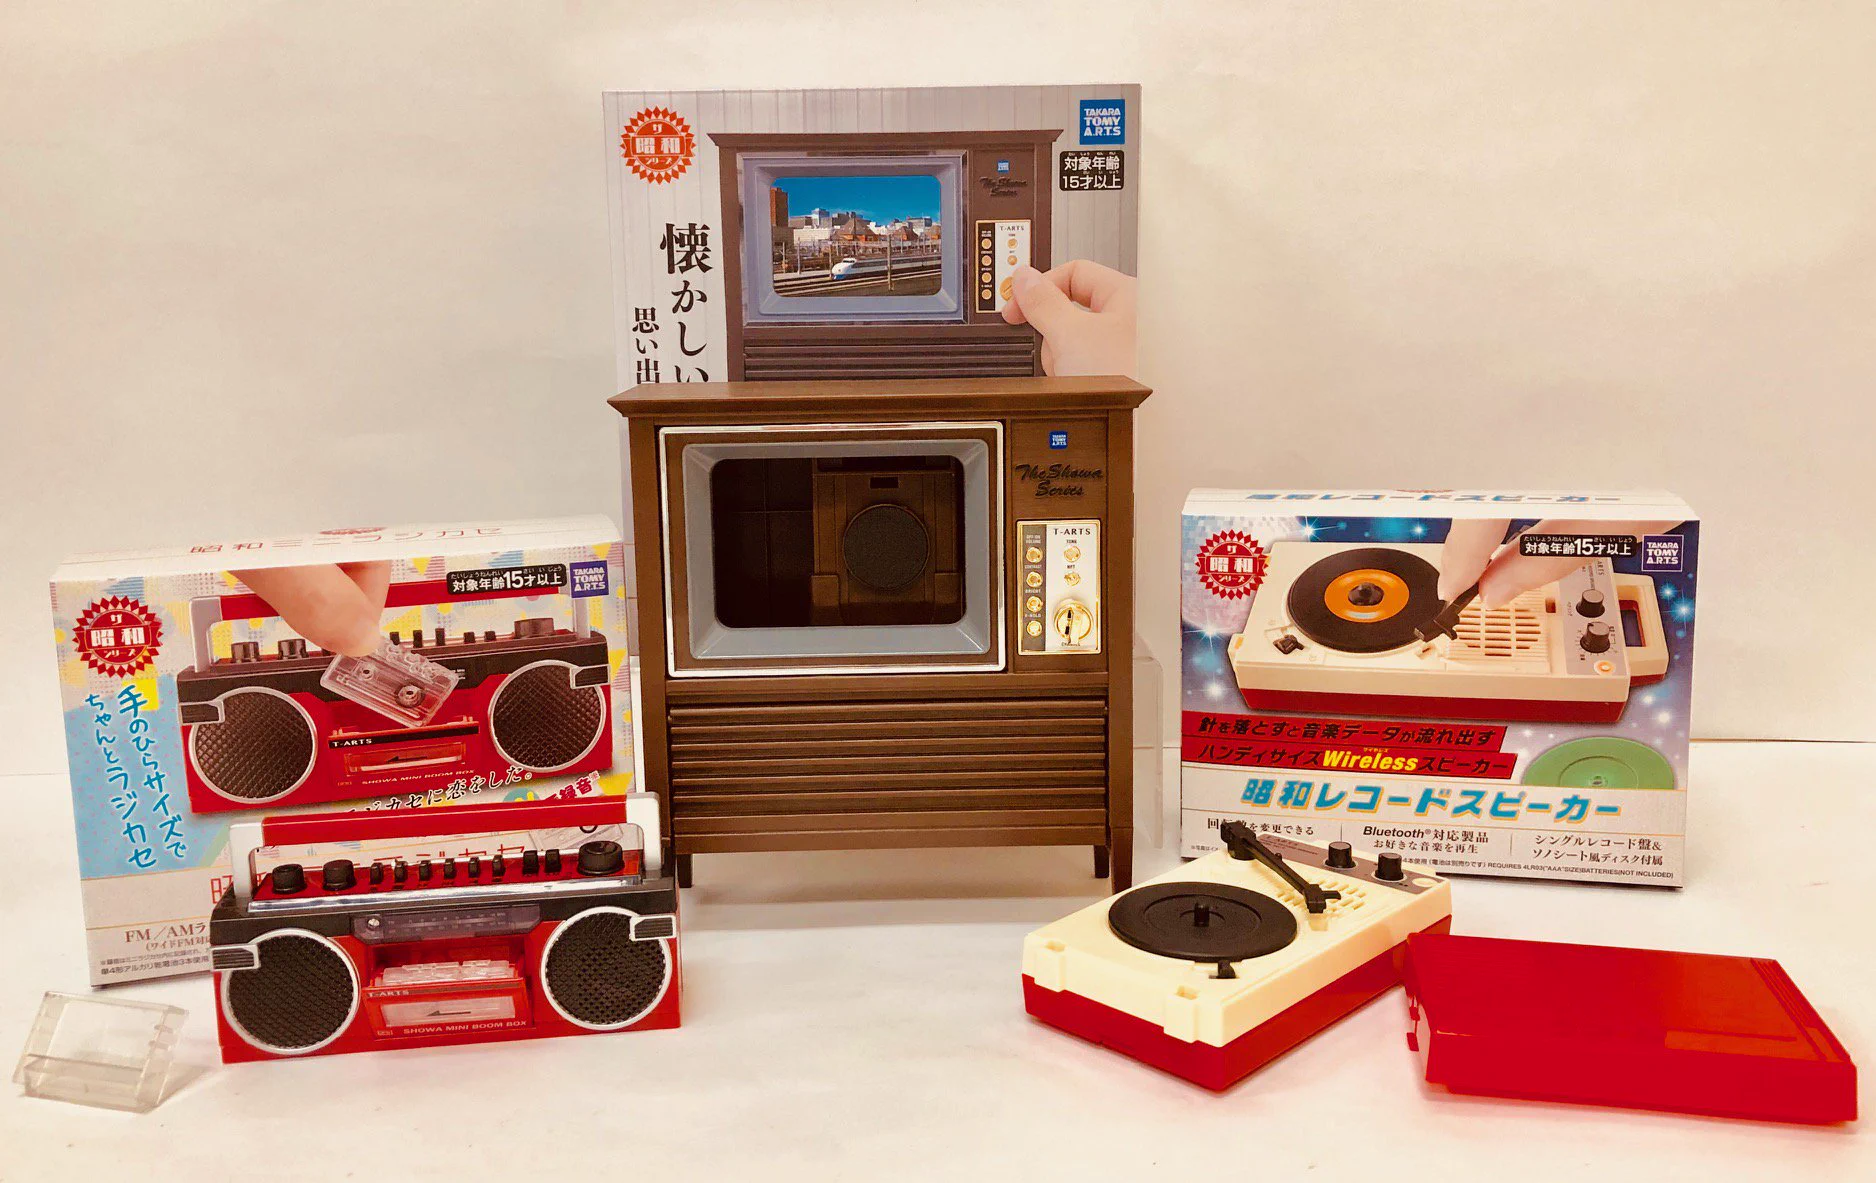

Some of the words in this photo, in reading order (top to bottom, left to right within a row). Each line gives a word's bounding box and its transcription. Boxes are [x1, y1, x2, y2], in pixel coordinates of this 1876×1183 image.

[1083, 108, 1121, 116] TAKARA
[1083, 116, 1121, 126] TOMY
[636, 137, 680, 154] 昭和
[1064, 156, 1120, 171] 対象年齢
[1062, 173, 1121, 190] 15才以上
[660, 222, 713, 383] 懐かしい
[632, 307, 660, 384] 思い出
[1015, 464, 1046, 480] The
[1047, 463, 1104, 479] Showa
[1035, 479, 1085, 497] Series
[1053, 527, 1091, 536] T-ARTS
[1525, 538, 1632, 556] 対象年齢15才以上
[1646, 541, 1679, 549] TAKARA
[1646, 548, 1679, 557] TOMY
[572, 566, 605, 574] TAKARA
[1210, 557, 1253, 573] 昭和
[452, 570, 563, 593] 対象年齢15才以上
[573, 574, 605, 583] TOMY
[90, 627, 145, 647] 昭和
[1199, 716, 1497, 746] 針を落とすと音楽データが流れ出す
[332, 738, 372, 747] T-ARTS
[117, 684, 188, 859] 手のひらサイズで
[362, 777, 398, 785] SHOWA
[424, 771, 453, 779] BOOM
[85, 693, 157, 869] ちゃんとラジカセ
[1240, 778, 1622, 824] 昭和レコードスピーカー
[1207, 817, 1315, 836] 回を変更できる
[1373, 839, 1479, 854] お好きな音楽を再生
[1532, 847, 1664, 866] ソノシート風ディスク付属
[1488, 862, 1522, 870] REQUIRES
[367, 989, 410, 998] T-ARTS
[403, 1026, 443, 1035] SHOWA
[445, 1024, 469, 1032] MINI
[472, 1021, 503, 1030] BOOM
